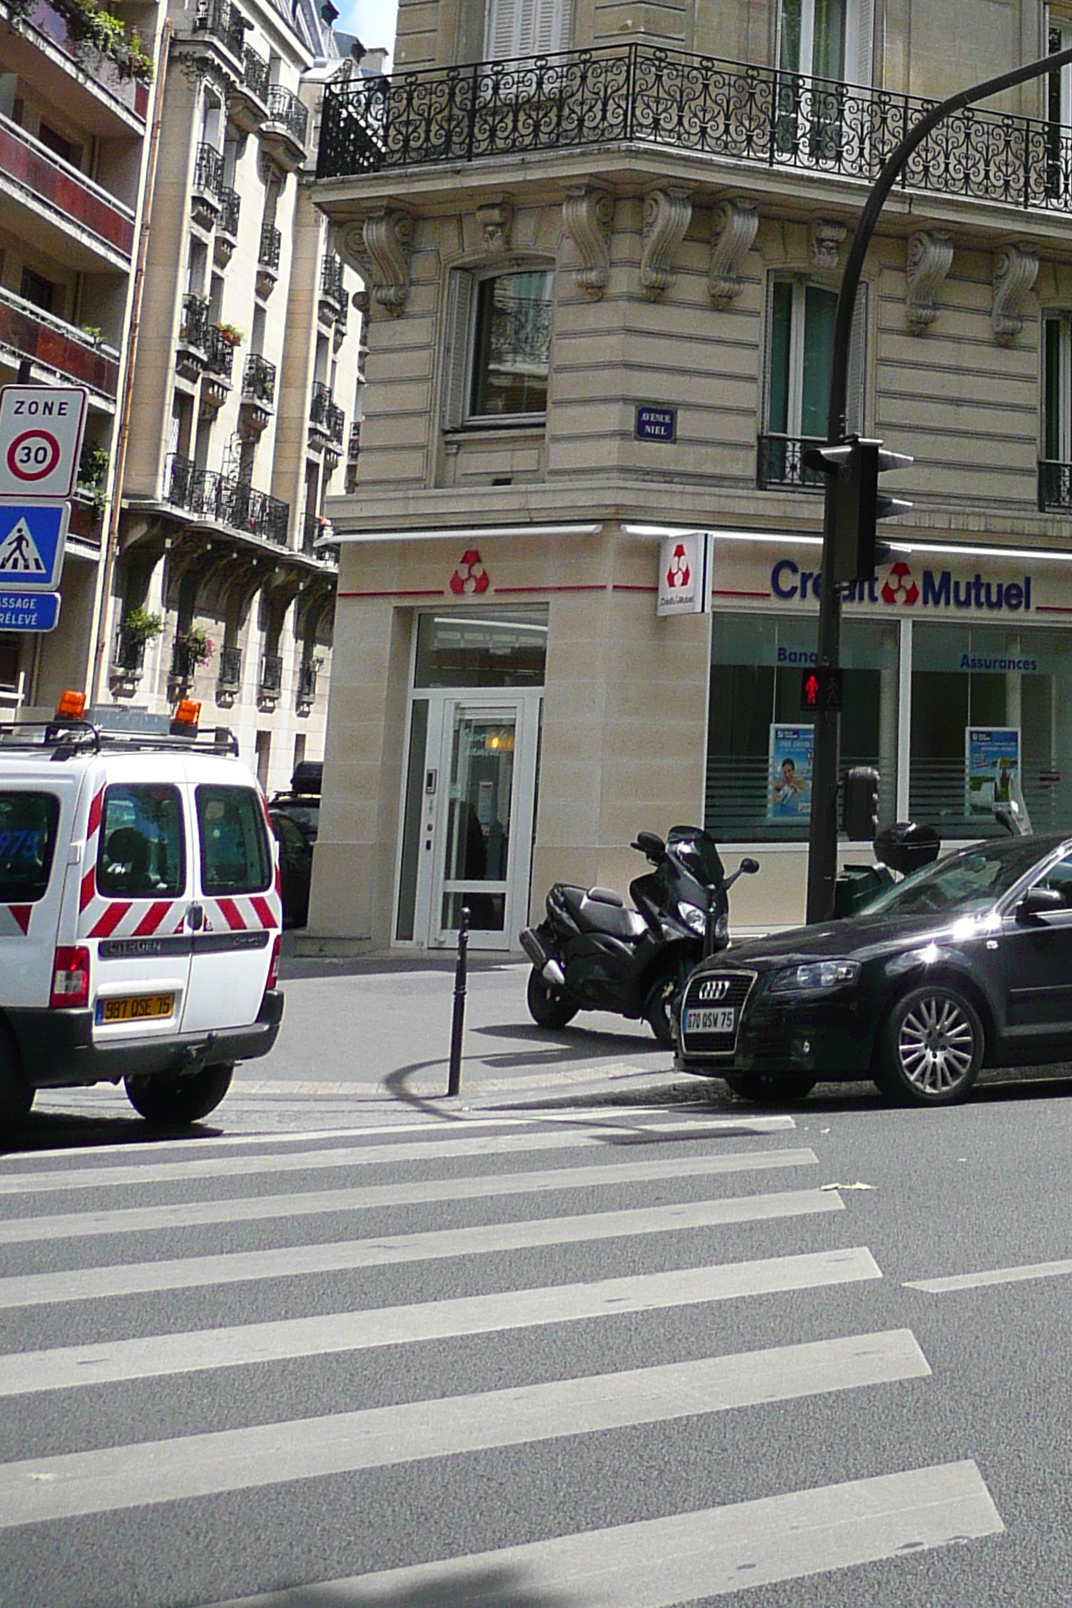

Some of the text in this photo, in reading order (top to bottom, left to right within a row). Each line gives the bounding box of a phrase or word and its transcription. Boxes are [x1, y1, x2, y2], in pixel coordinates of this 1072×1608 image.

[13, 400, 68, 416] ZONE
[641, 412, 671, 423] AVENUE
[645, 425, 667, 435] NIEL
[19, 446, 47, 464] 30
[922, 570, 1031, 609] Mutuel
[960, 653, 1037, 671] Assurances
[131, 998, 153, 1017] QSE
[156, 996, 171, 1014] 75
[721, 1011, 733, 1028] 75
